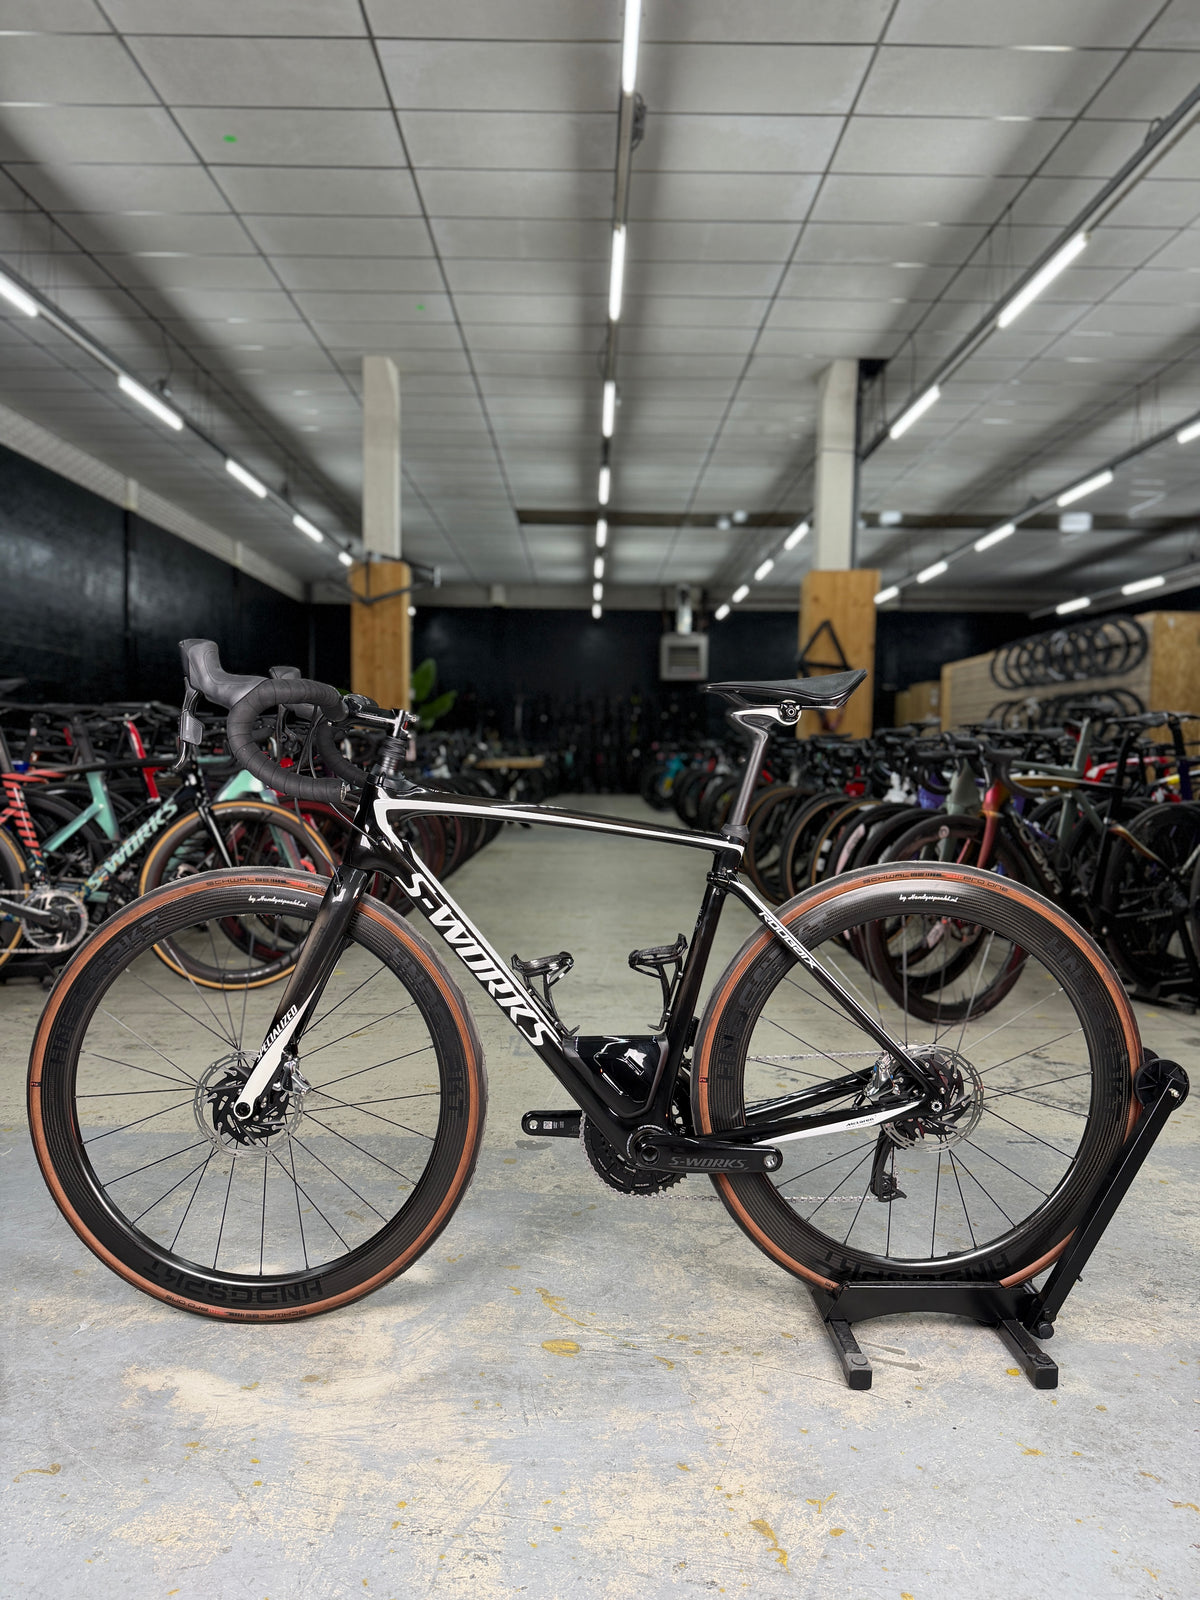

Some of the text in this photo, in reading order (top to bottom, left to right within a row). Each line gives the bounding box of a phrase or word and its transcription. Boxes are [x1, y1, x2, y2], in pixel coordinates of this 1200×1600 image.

[87, 797, 178, 893] S-WORKS
[394, 872, 563, 1051] S-WORKS
[668, 1156, 747, 1169] S-WORKS
[144, 1261, 323, 1303] HNDGSPKT
